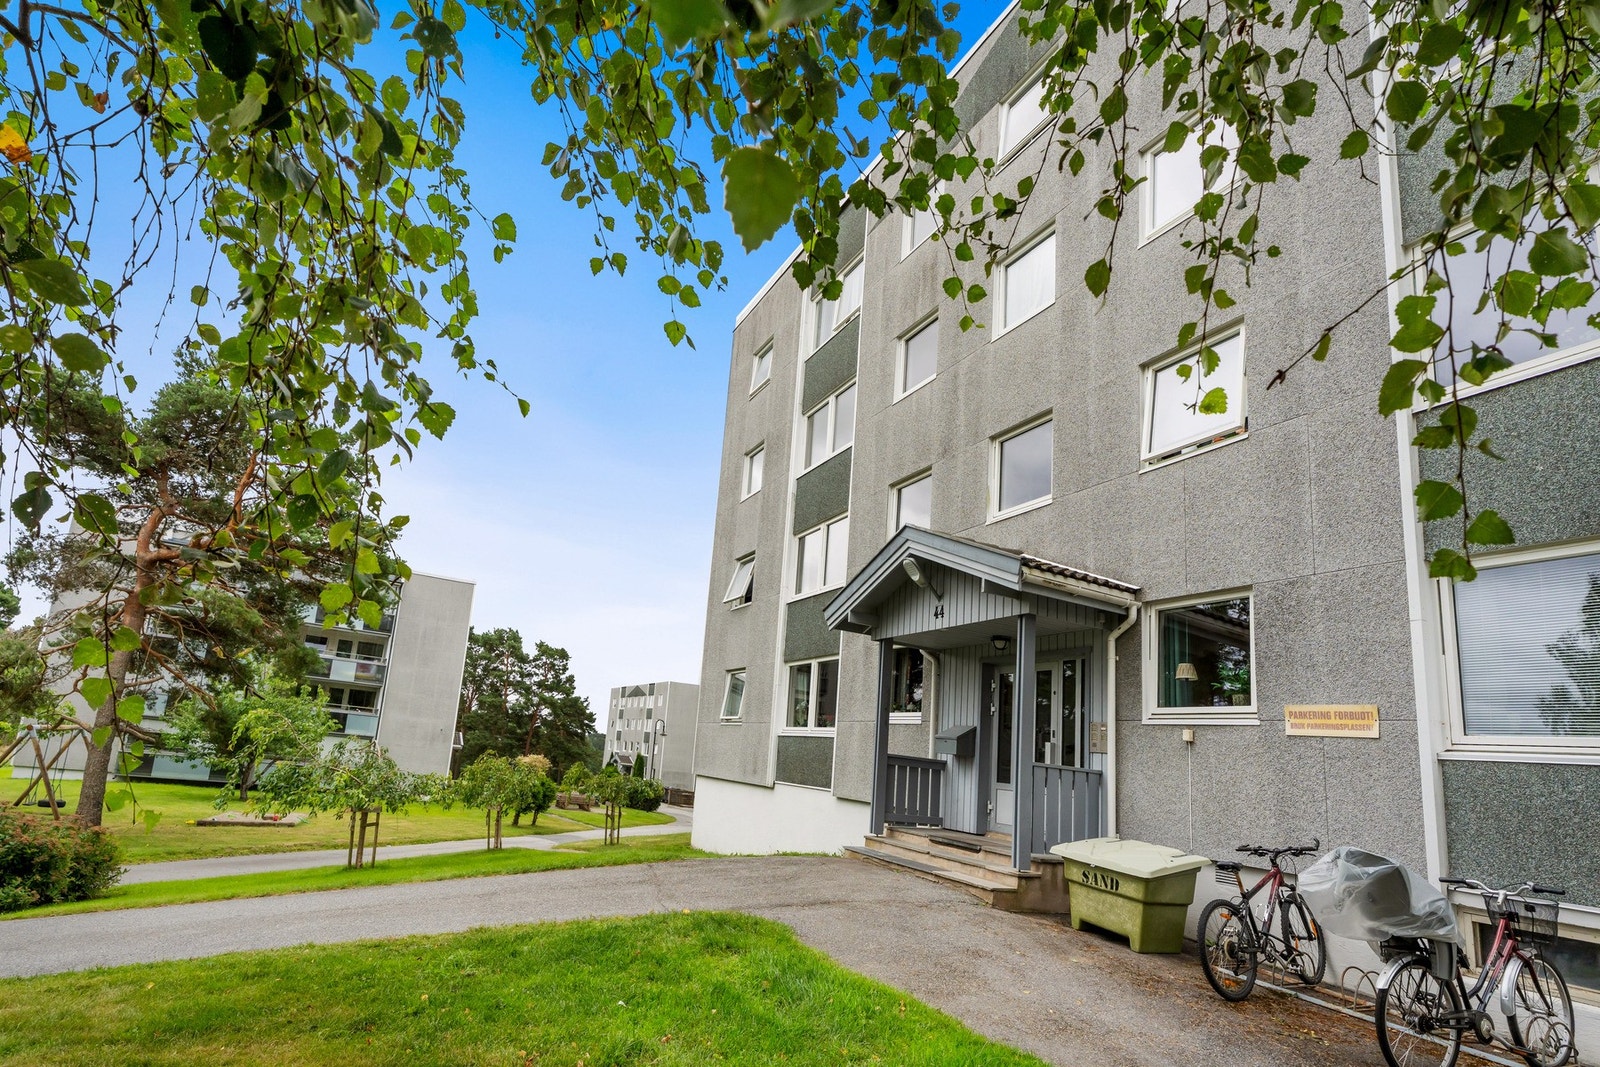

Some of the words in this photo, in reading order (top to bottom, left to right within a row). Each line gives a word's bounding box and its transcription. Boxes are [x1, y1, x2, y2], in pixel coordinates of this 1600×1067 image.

[934, 605, 944, 619] 44
[1288, 710, 1331, 720] PARKERING
[1334, 711, 1374, 721] FORBUDT!
[1290, 722, 1306, 730] BRUK
[1081, 869, 1120, 892] SAND
